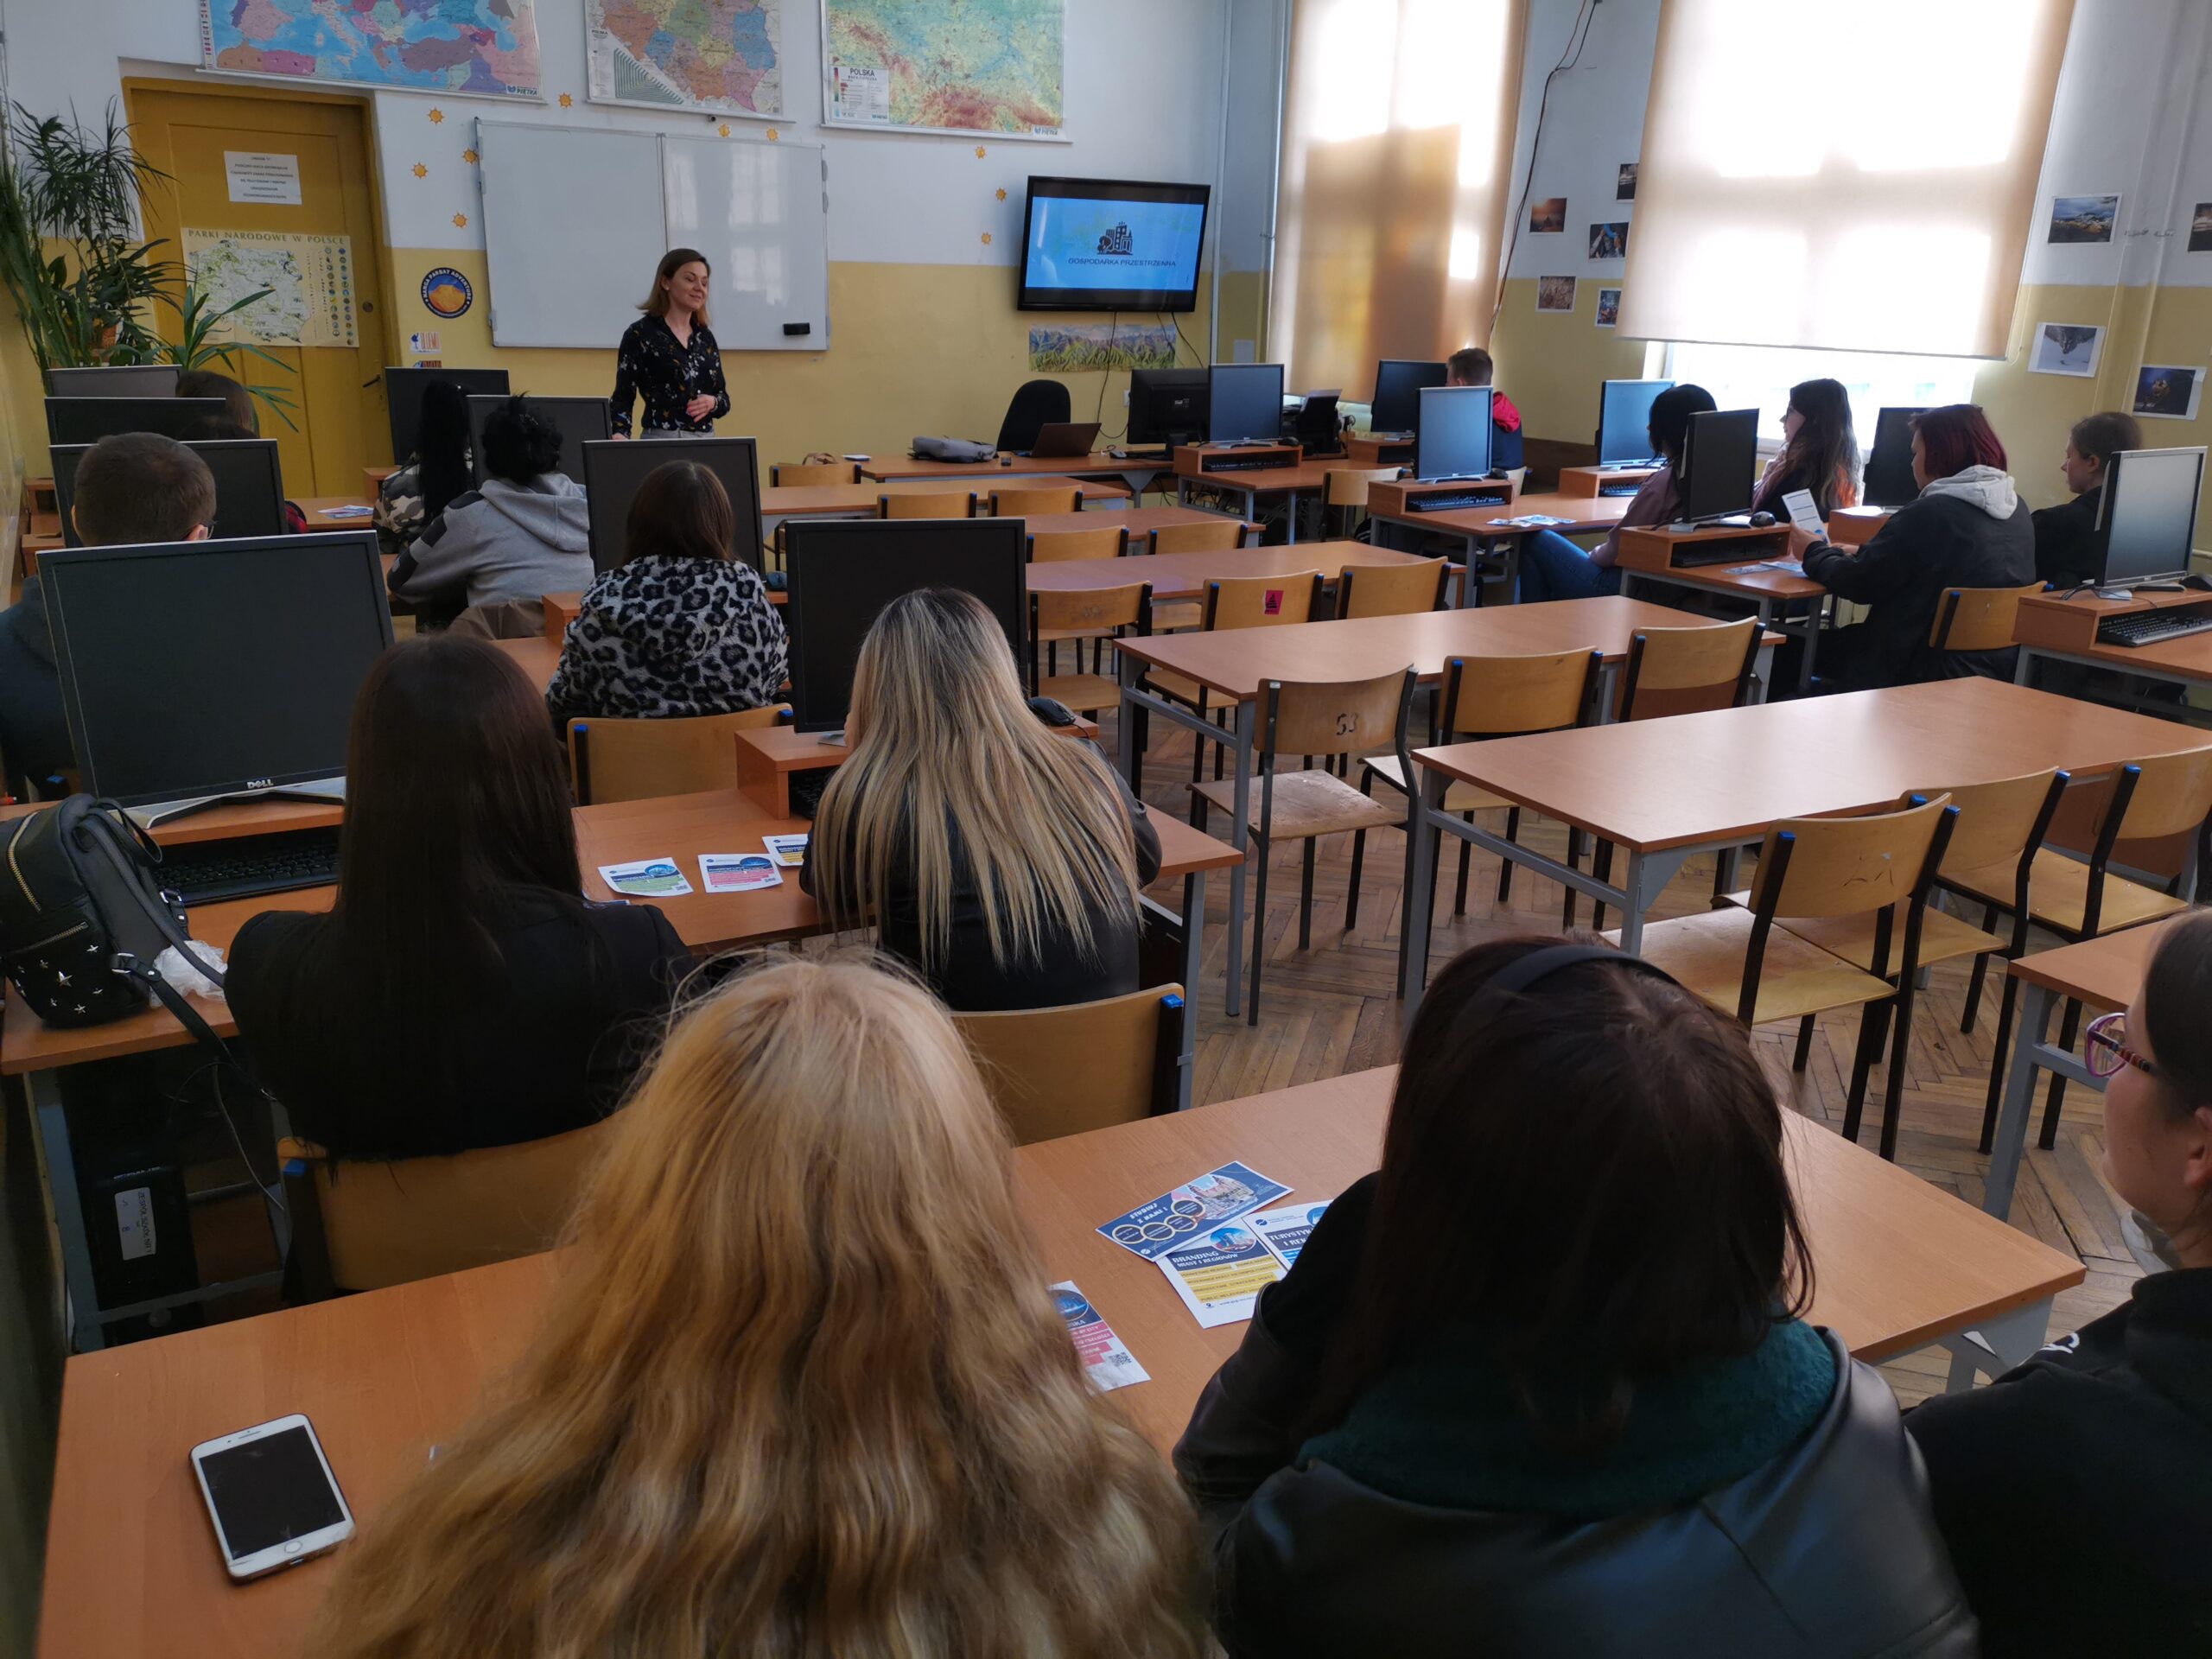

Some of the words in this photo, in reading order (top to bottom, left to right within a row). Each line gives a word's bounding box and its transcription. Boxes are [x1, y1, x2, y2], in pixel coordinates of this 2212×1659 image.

[849, 67, 875, 76] POLSKA
[188, 230, 219, 238] PARKI
[225, 232, 288, 242] NARODOWE
[1121, 258, 1176, 267] PRZESTRZENNA
[246, 779, 274, 789] DELL
[1129, 1203, 1157, 1219] STUDIUJ
[1268, 1228, 1313, 1241] TURYSTYK
[1172, 1250, 1219, 1263] BRANDING
